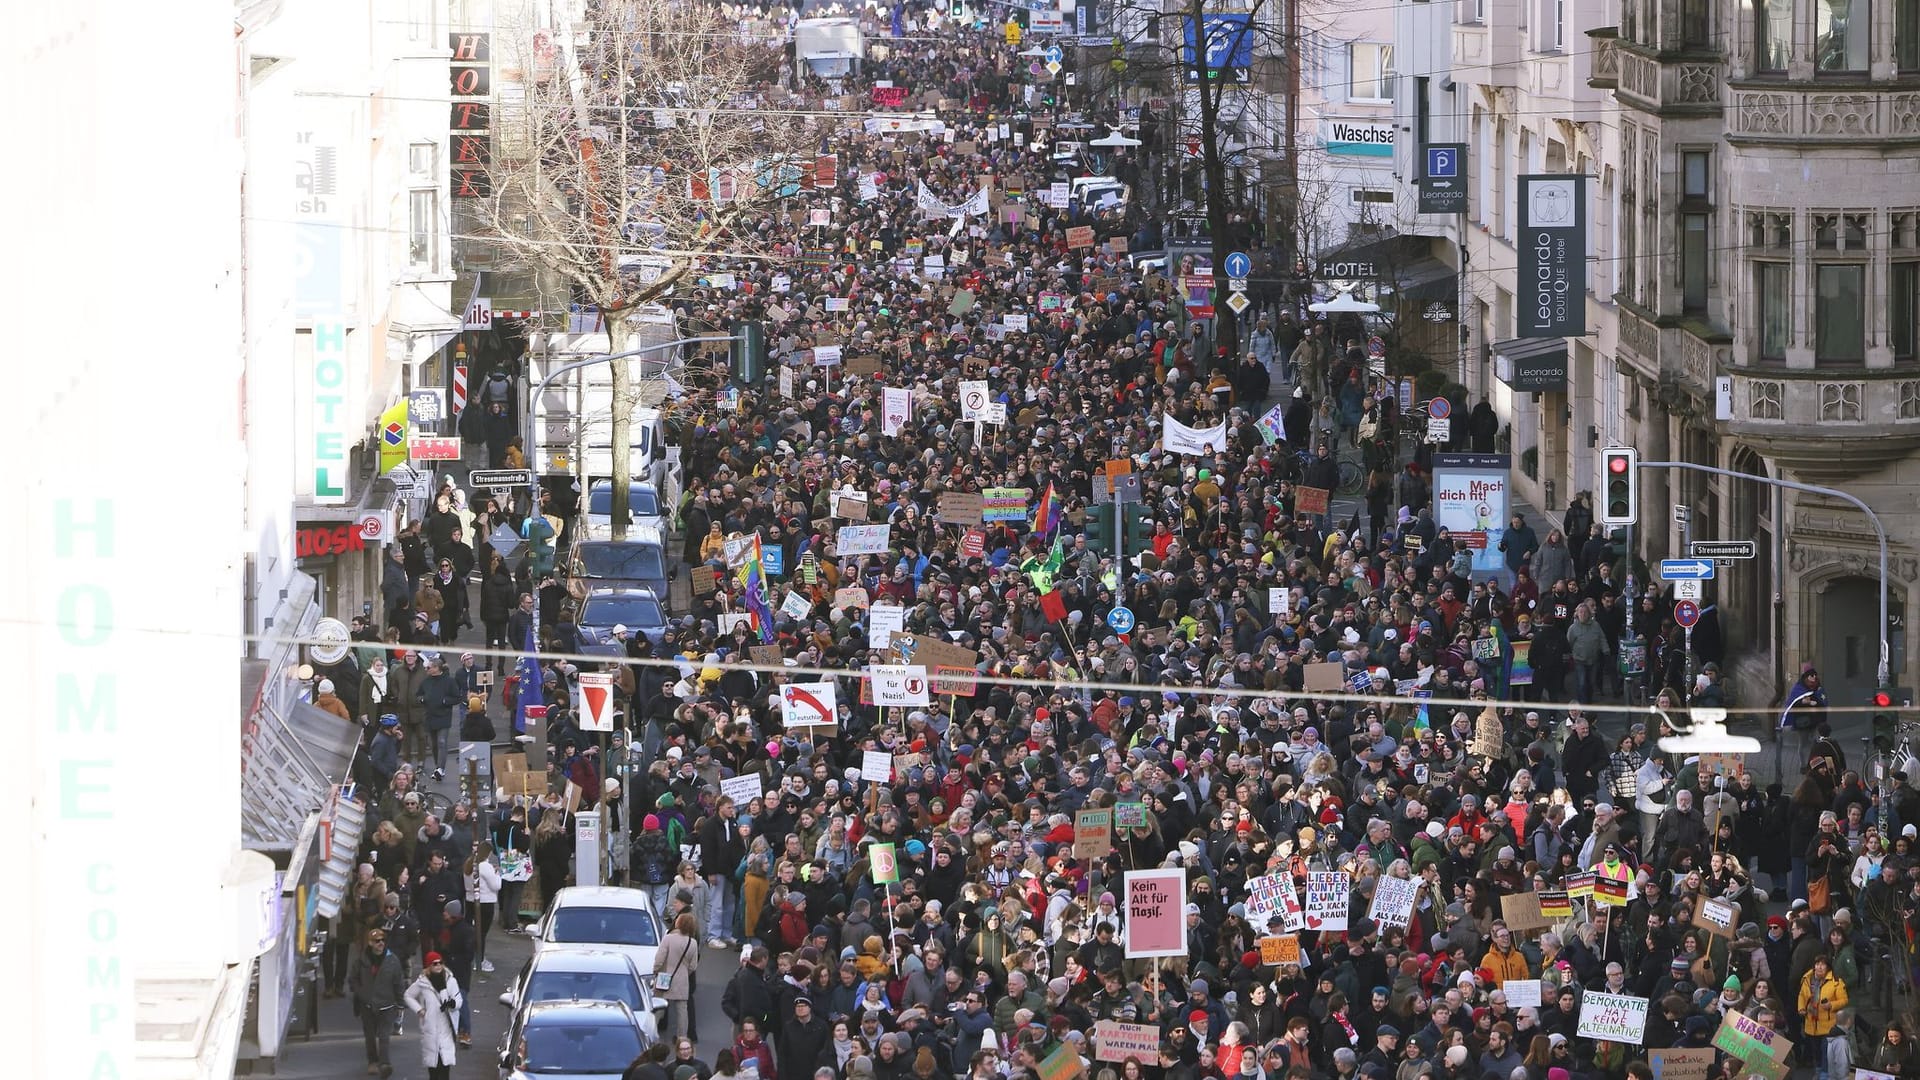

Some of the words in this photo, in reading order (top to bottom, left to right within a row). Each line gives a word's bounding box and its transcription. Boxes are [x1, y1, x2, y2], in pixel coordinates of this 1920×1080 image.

[455, 36, 481, 197] HOTEL
[1423, 191, 1463, 199] Leonardo
[1556, 238, 1564, 263] Hotel
[1323, 263, 1378, 276] HOTEL
[1534, 233, 1551, 327] Leonardo
[1553, 268, 1569, 322] BOUTIQUE
[1520, 368, 1563, 376] Leonardo
[316, 324, 343, 496] HOTEL
[475, 475, 527, 484] Stresemannstraße
[1470, 481, 1503, 491] Mach
[1439, 490, 1465, 501] dich
[1469, 491, 1486, 501] fit!
[1698, 546, 1749, 555] Stresemannstraße
[1477, 639, 1494, 650] FCK
[1478, 650, 1495, 658] AFD
[55, 500, 116, 820] HOME
[882, 692, 905, 700] Nazis!
[1251, 872, 1289, 891] LIEBER
[1308, 873, 1347, 883] LIEBER
[1131, 881, 1157, 891] Kein
[1308, 883, 1348, 892] KUNTER-
[1131, 894, 1148, 904] Alt
[1152, 893, 1168, 904] für
[1254, 883, 1293, 903] KUNTER-
[1311, 893, 1343, 902] BUNT
[1257, 894, 1289, 913] BUNT
[1308, 903, 1323, 911] ALS
[1327, 901, 1347, 910] KACK-
[1272, 907, 1285, 916] ALS
[1320, 911, 1346, 919] BRAUN
[1584, 994, 1645, 1012] DEMOKRATIE
[1604, 1008, 1627, 1017] HAT
[1593, 1014, 1626, 1025] KEINE
[1579, 1022, 1640, 1038] ALTERNATIVE
[1735, 1016, 1774, 1045] HASS
[1105, 1041, 1136, 1050] WAREN
